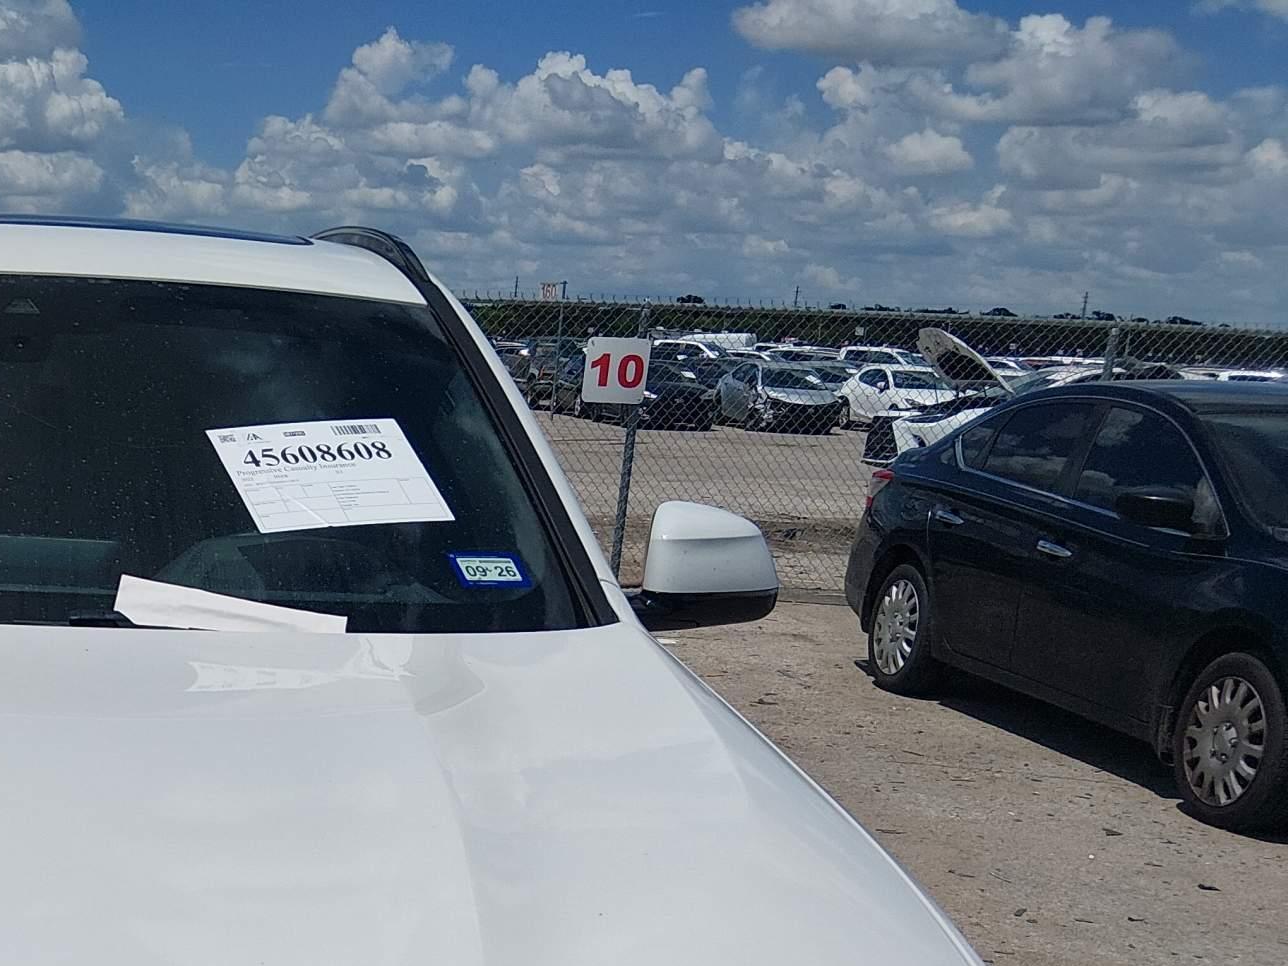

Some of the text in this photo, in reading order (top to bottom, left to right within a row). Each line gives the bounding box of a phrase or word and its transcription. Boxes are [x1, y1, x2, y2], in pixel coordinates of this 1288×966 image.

[590, 353, 645, 389] 10
[243, 440, 392, 467] 45608608
[465, 565, 517, 577] 09 26
